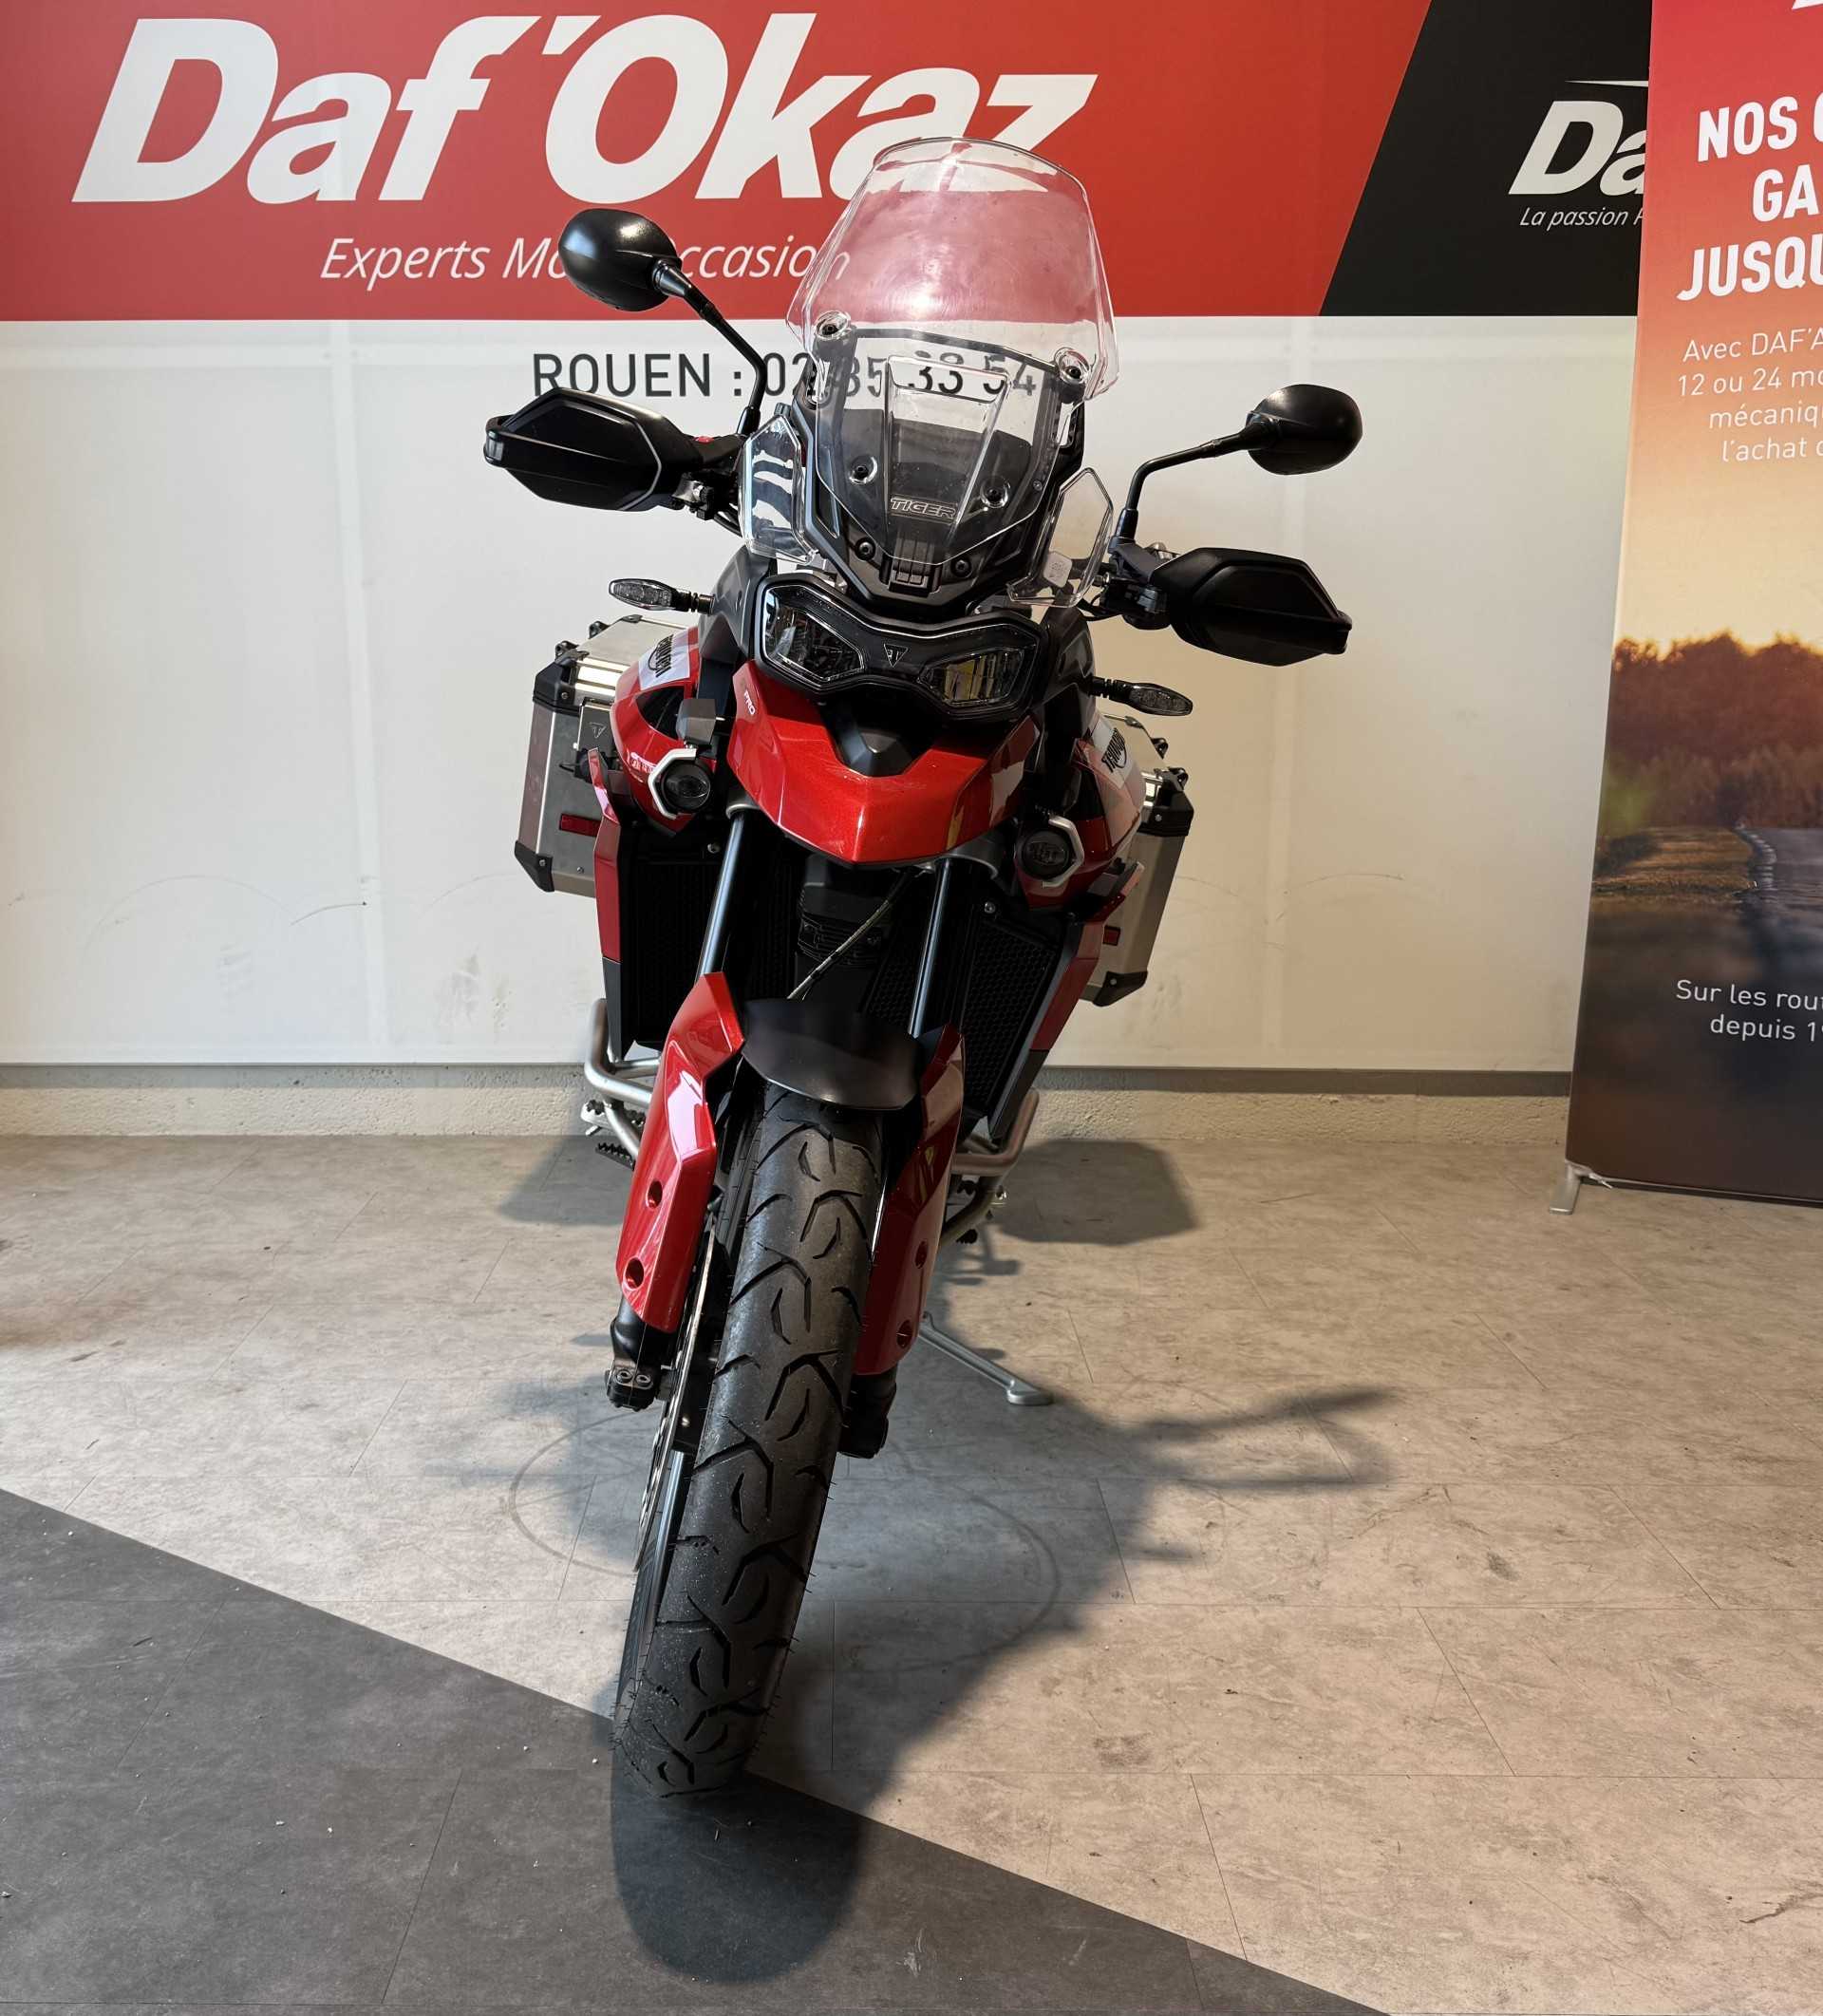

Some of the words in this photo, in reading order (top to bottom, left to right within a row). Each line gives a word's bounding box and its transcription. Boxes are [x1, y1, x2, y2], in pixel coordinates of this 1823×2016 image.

[1698, 96, 1798, 162] NOS
[1753, 164, 1820, 222] GA
[1519, 207, 1546, 226] La
[1546, 206, 1629, 231] passion
[320, 237, 491, 292] Experts
[501, 237, 572, 278] Mo
[669, 235, 851, 280] ccasion
[1682, 340, 1741, 363] Avec
[533, 353, 710, 397] ROUEN
[1678, 373, 1705, 396] 12
[1713, 376, 1743, 394] ou
[1753, 367, 1782, 390] 24
[1709, 400, 1823, 428] mécaniq
[1722, 437, 1807, 462] l'achat
[890, 498, 957, 519] TIGER
[743, 689, 756, 715] PRO
[1676, 979, 1722, 1002] Sur
[1730, 984, 1767, 1007] les
[1776, 993, 1823, 1011] rou
[1710, 1013, 1795, 1041] depuis
[1807, 1022, 1823, 1042] 1
